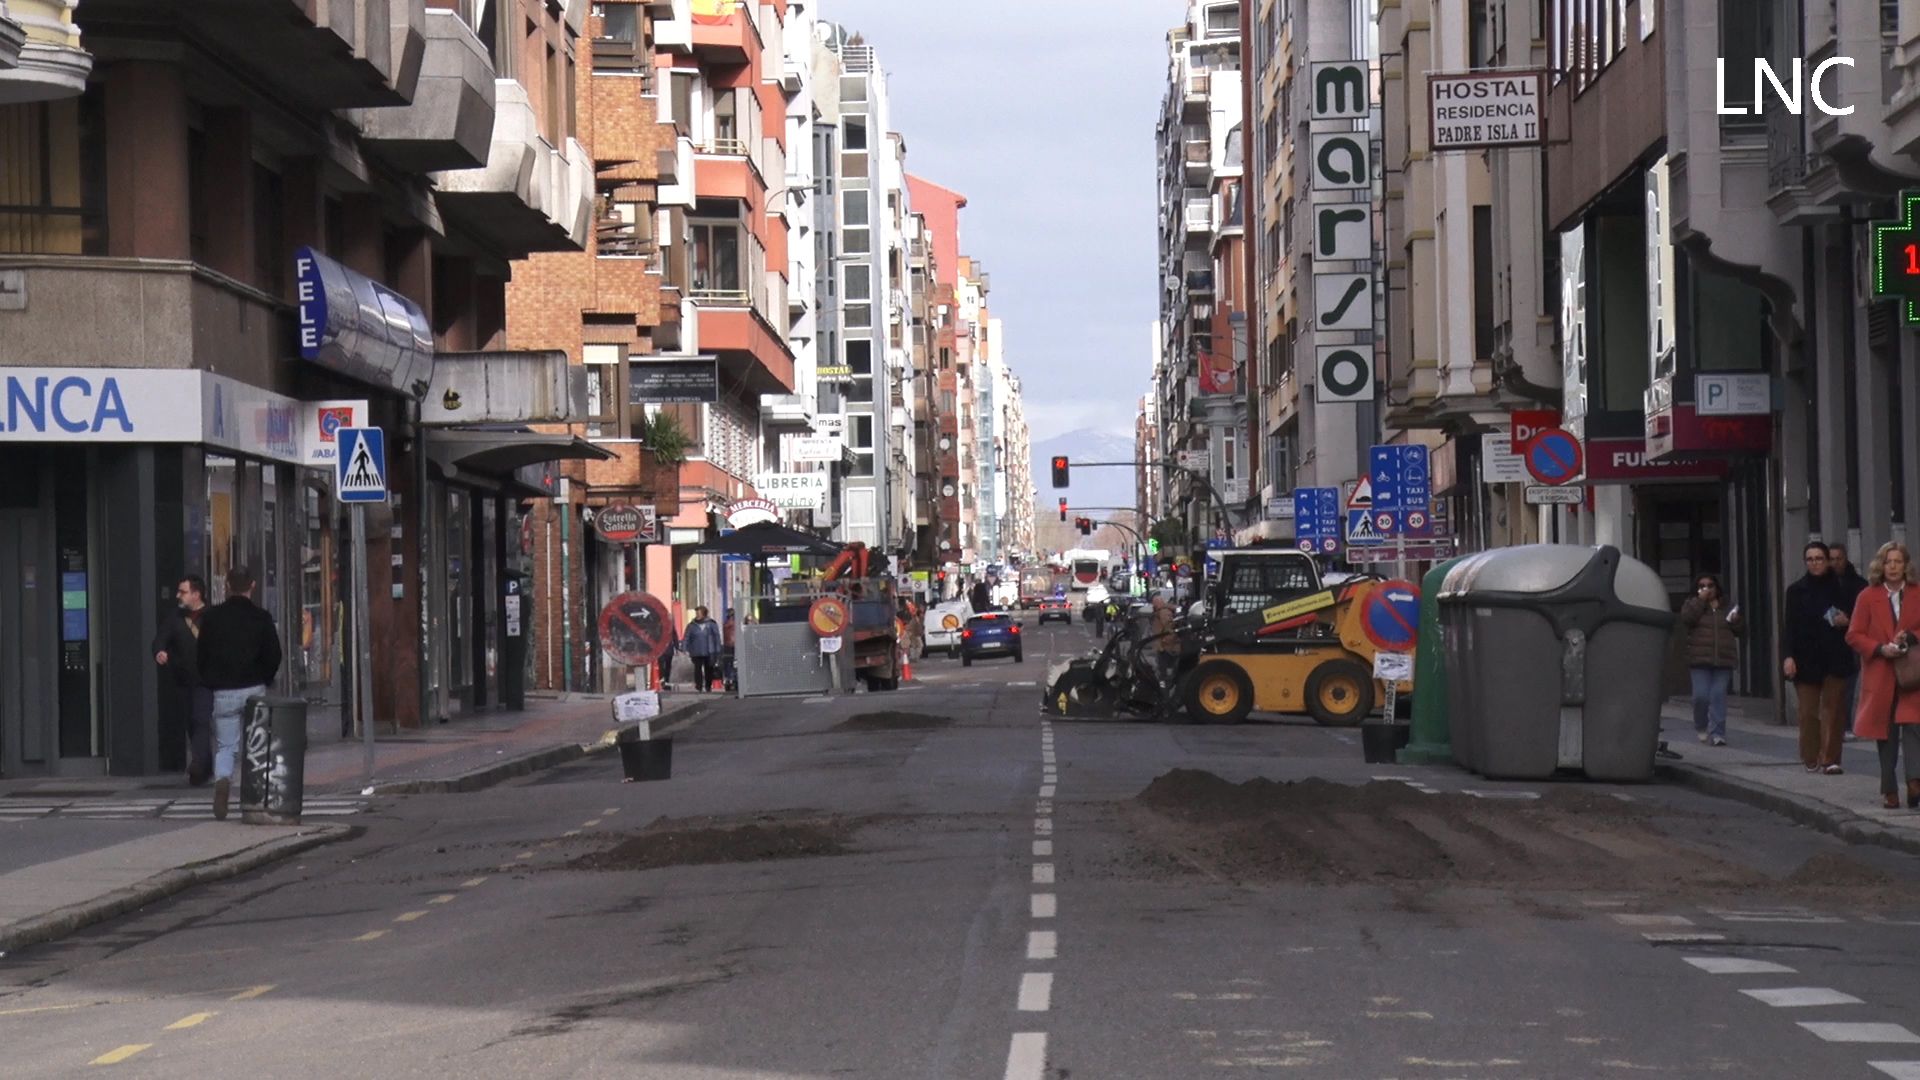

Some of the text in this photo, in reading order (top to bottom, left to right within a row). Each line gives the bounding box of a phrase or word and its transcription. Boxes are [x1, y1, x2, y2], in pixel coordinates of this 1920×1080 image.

[1436, 80, 1535, 100] HOSTAL
[1437, 103, 1535, 120] RESIDENCIA
[1438, 122, 1536, 143] PADRE ISLA II
[297, 258, 318, 348] FELE
[816, 366, 850, 375] HOSTAL
[1709, 384, 1723, 405] P
[0, 376, 134, 433] NCA
[757, 477, 823, 490] LIBRERIA
[1406, 487, 1425, 495] TAXI
[731, 499, 776, 514] MERCERIA
[1406, 497, 1424, 505] BUS
[602, 512, 637, 522] Estrella
[1379, 516, 1422, 526] 30 20
[603, 523, 636, 532] Galicia
[509, 580, 518, 593] P
